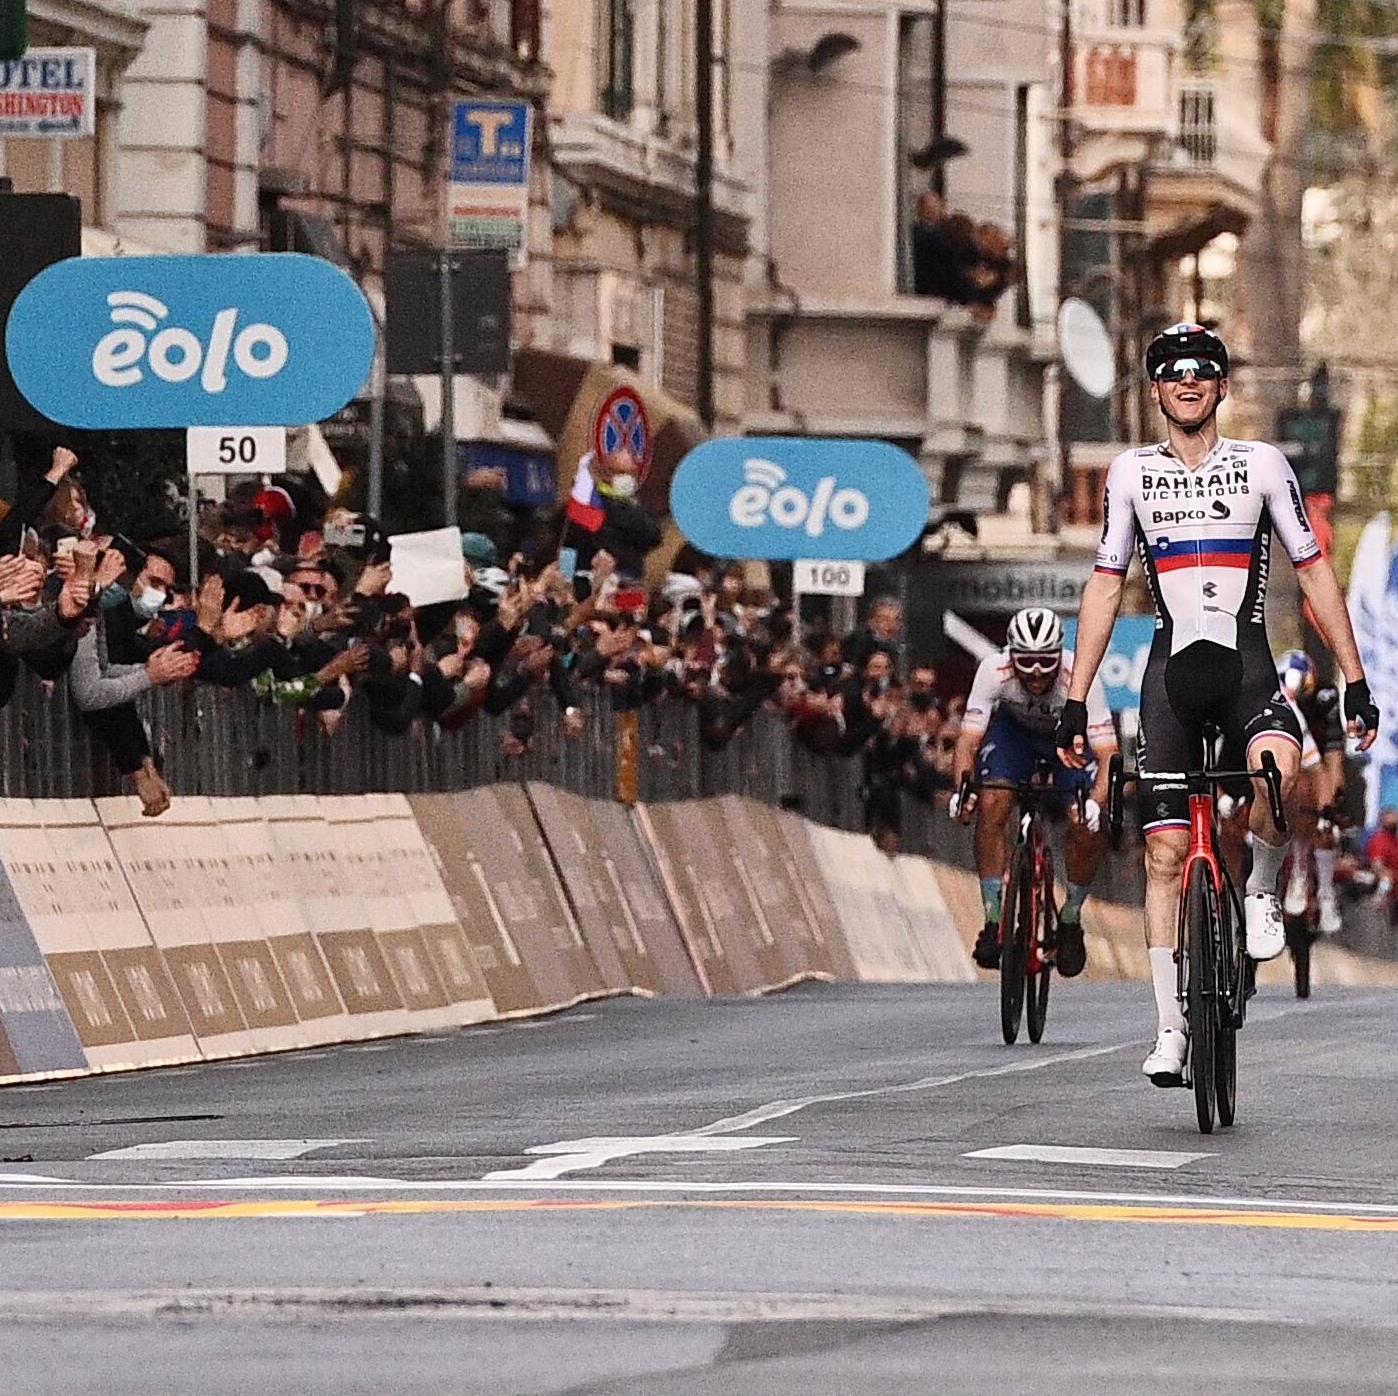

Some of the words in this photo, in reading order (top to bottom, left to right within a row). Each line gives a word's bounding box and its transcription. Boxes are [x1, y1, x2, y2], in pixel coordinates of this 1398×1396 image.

[93, 309, 288, 392] eolo
[219, 436, 257, 464] 50
[1142, 470, 1249, 490] BAHRAIN
[1142, 485, 1250, 501] VICTORIOUS
[730, 477, 870, 537] eolo
[1152, 508, 1206, 524] Bapco
[808, 566, 851, 587] 100
[1250, 532, 1270, 625] BAHRAIN
